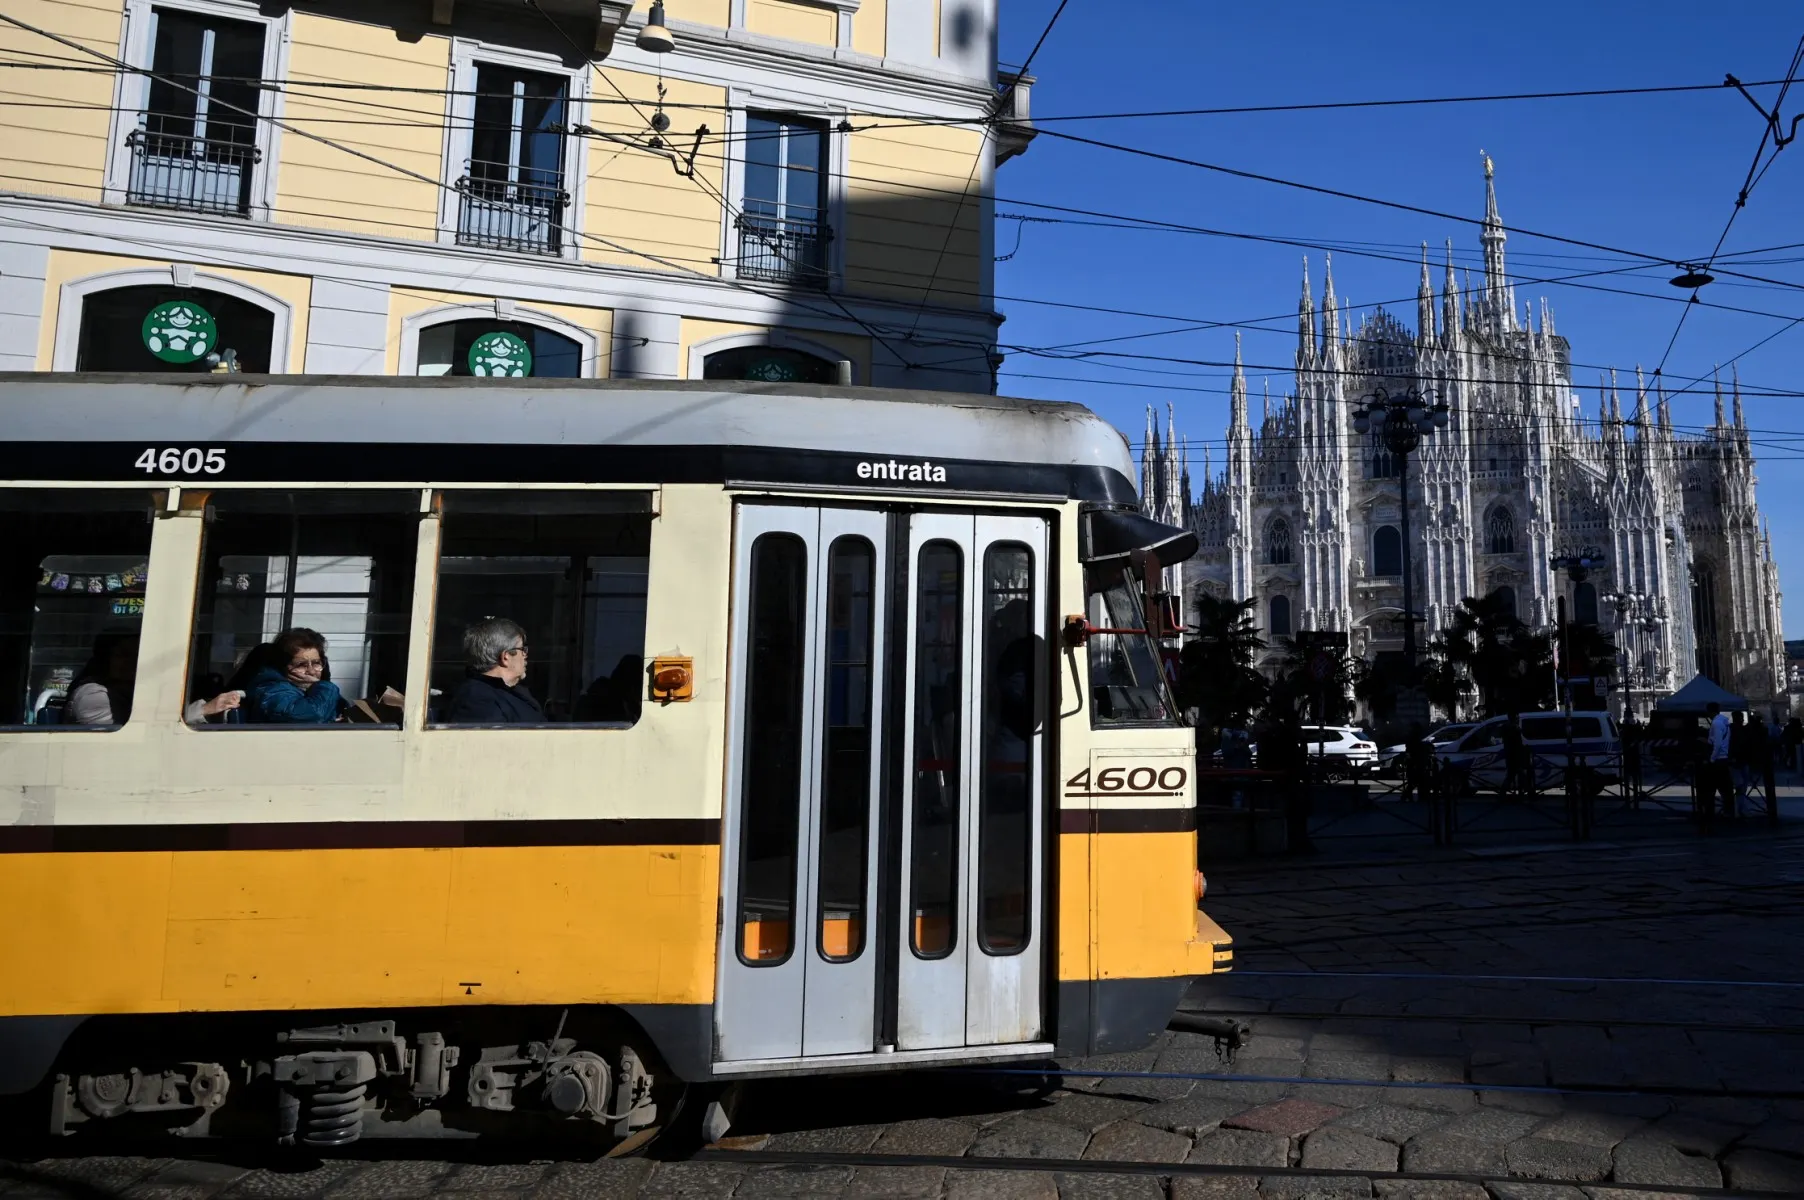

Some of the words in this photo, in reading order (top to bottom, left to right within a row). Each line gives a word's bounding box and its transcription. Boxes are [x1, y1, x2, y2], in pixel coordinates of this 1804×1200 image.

[135, 448, 226, 474] 4605
[856, 460, 946, 482] entrata
[1066, 767, 1187, 791] 4600
